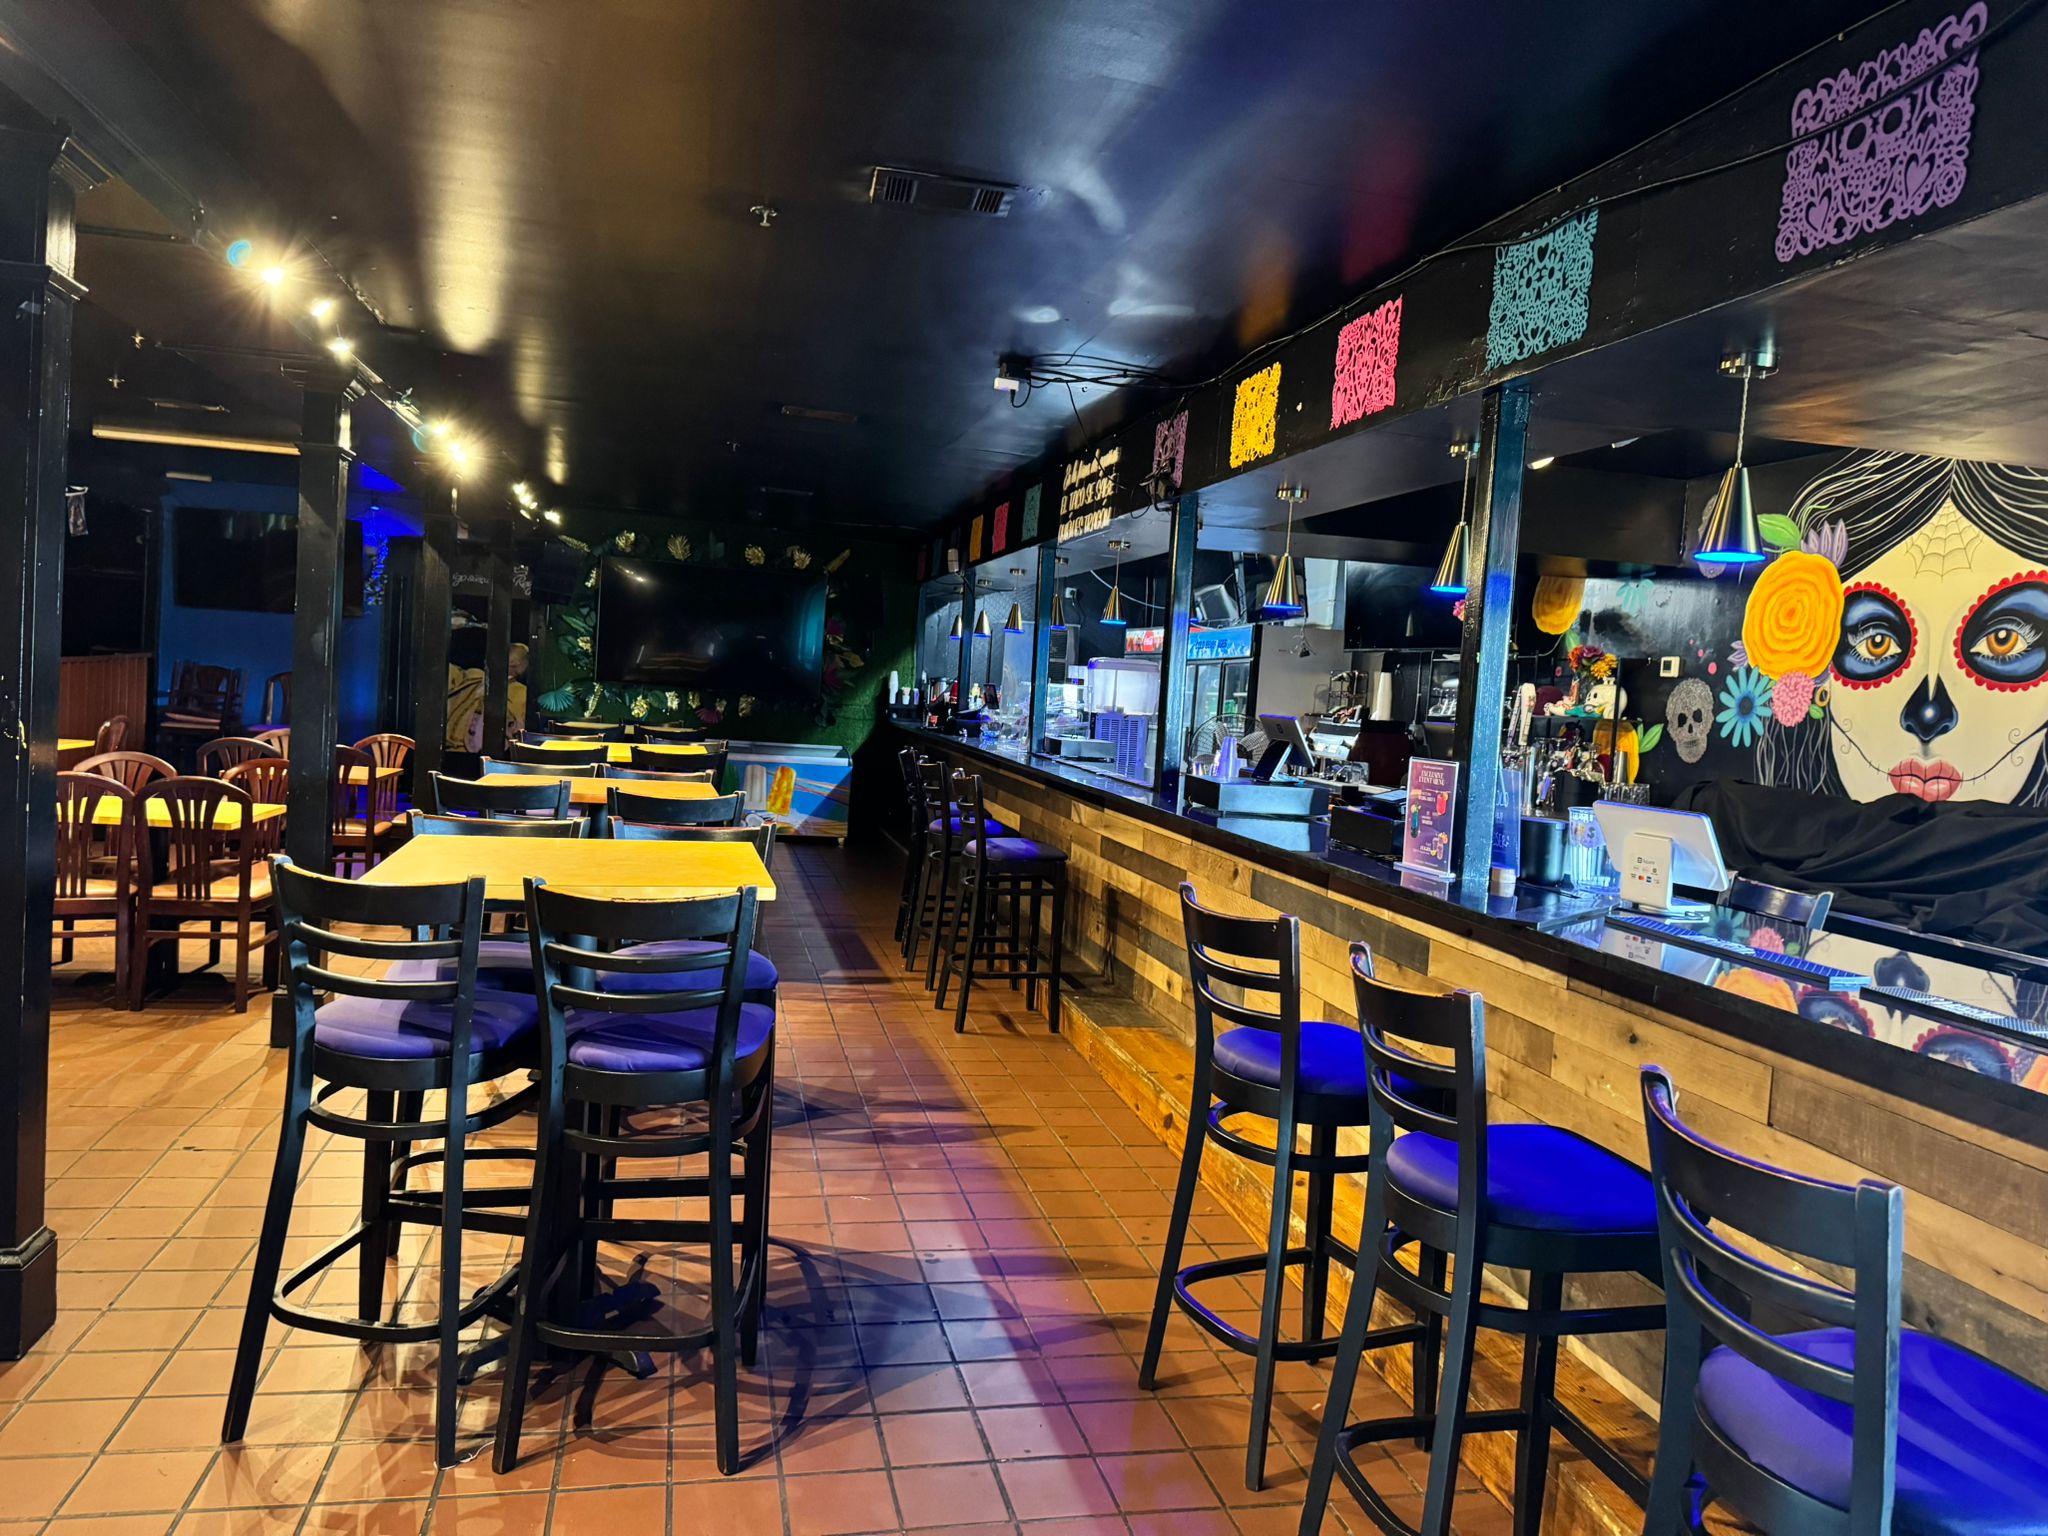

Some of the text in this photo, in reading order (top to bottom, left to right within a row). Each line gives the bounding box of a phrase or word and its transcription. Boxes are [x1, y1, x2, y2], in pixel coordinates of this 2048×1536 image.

[1069, 487, 1085, 511] TACO
[1085, 482, 1096, 504] SE
[1420, 770, 1444, 779] EXCLUSIVE
